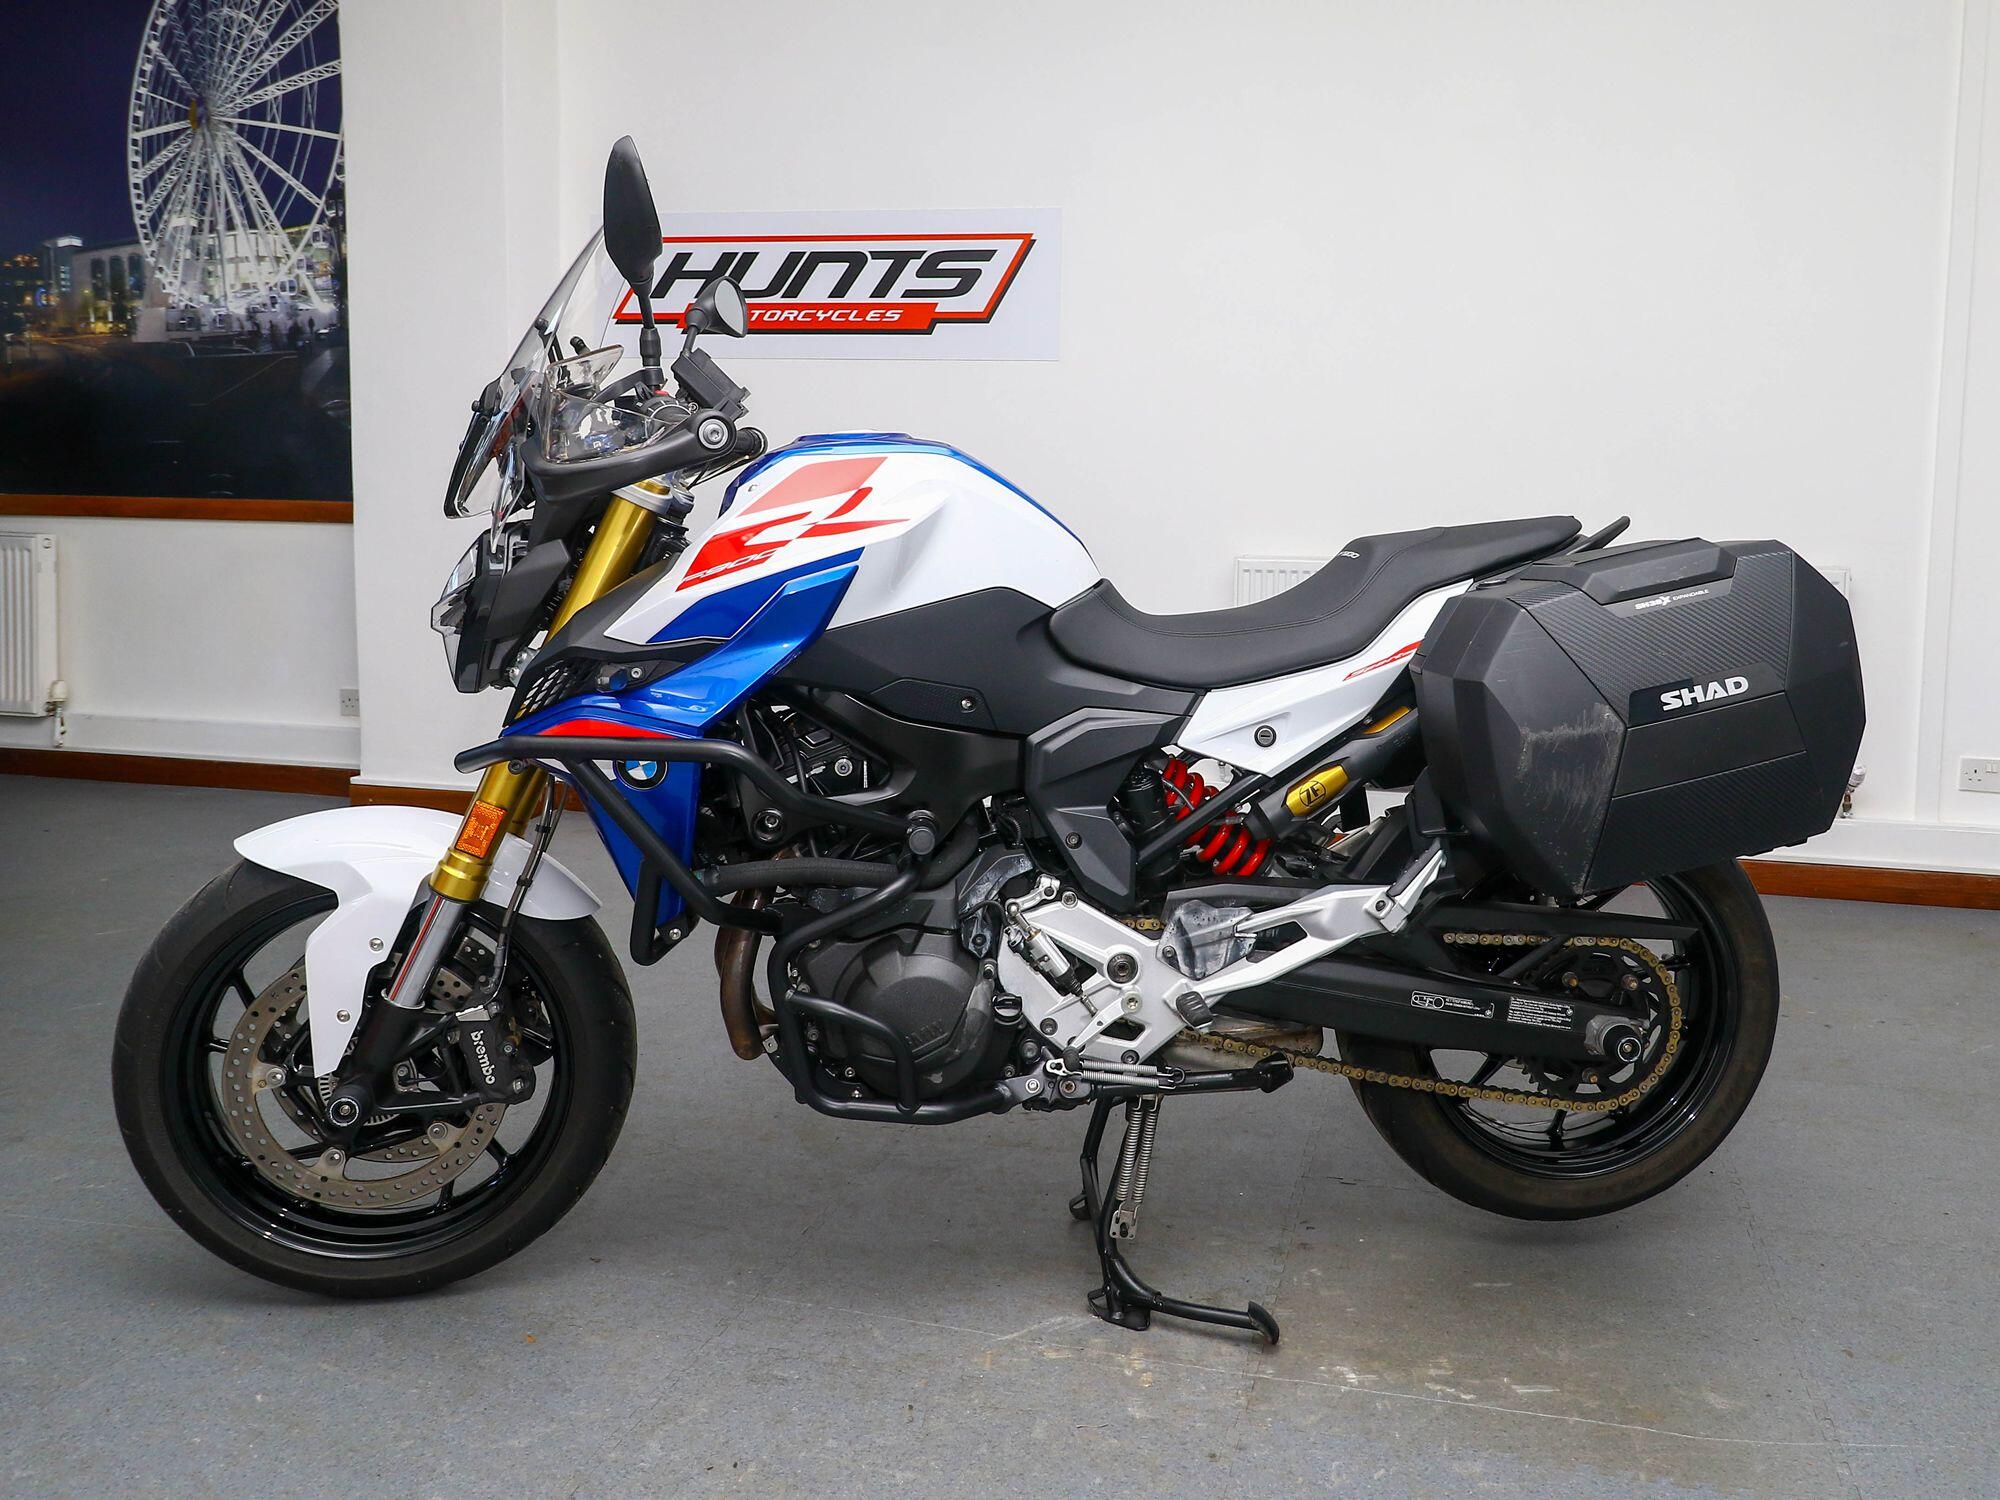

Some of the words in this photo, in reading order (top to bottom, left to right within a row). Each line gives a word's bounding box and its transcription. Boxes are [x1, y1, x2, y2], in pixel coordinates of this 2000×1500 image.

[650, 249, 998, 299] HUNTS
[750, 309, 904, 322] TORCYCLES
[1660, 676, 1749, 711] SHAD
[470, 1030, 496, 1085] brembo
